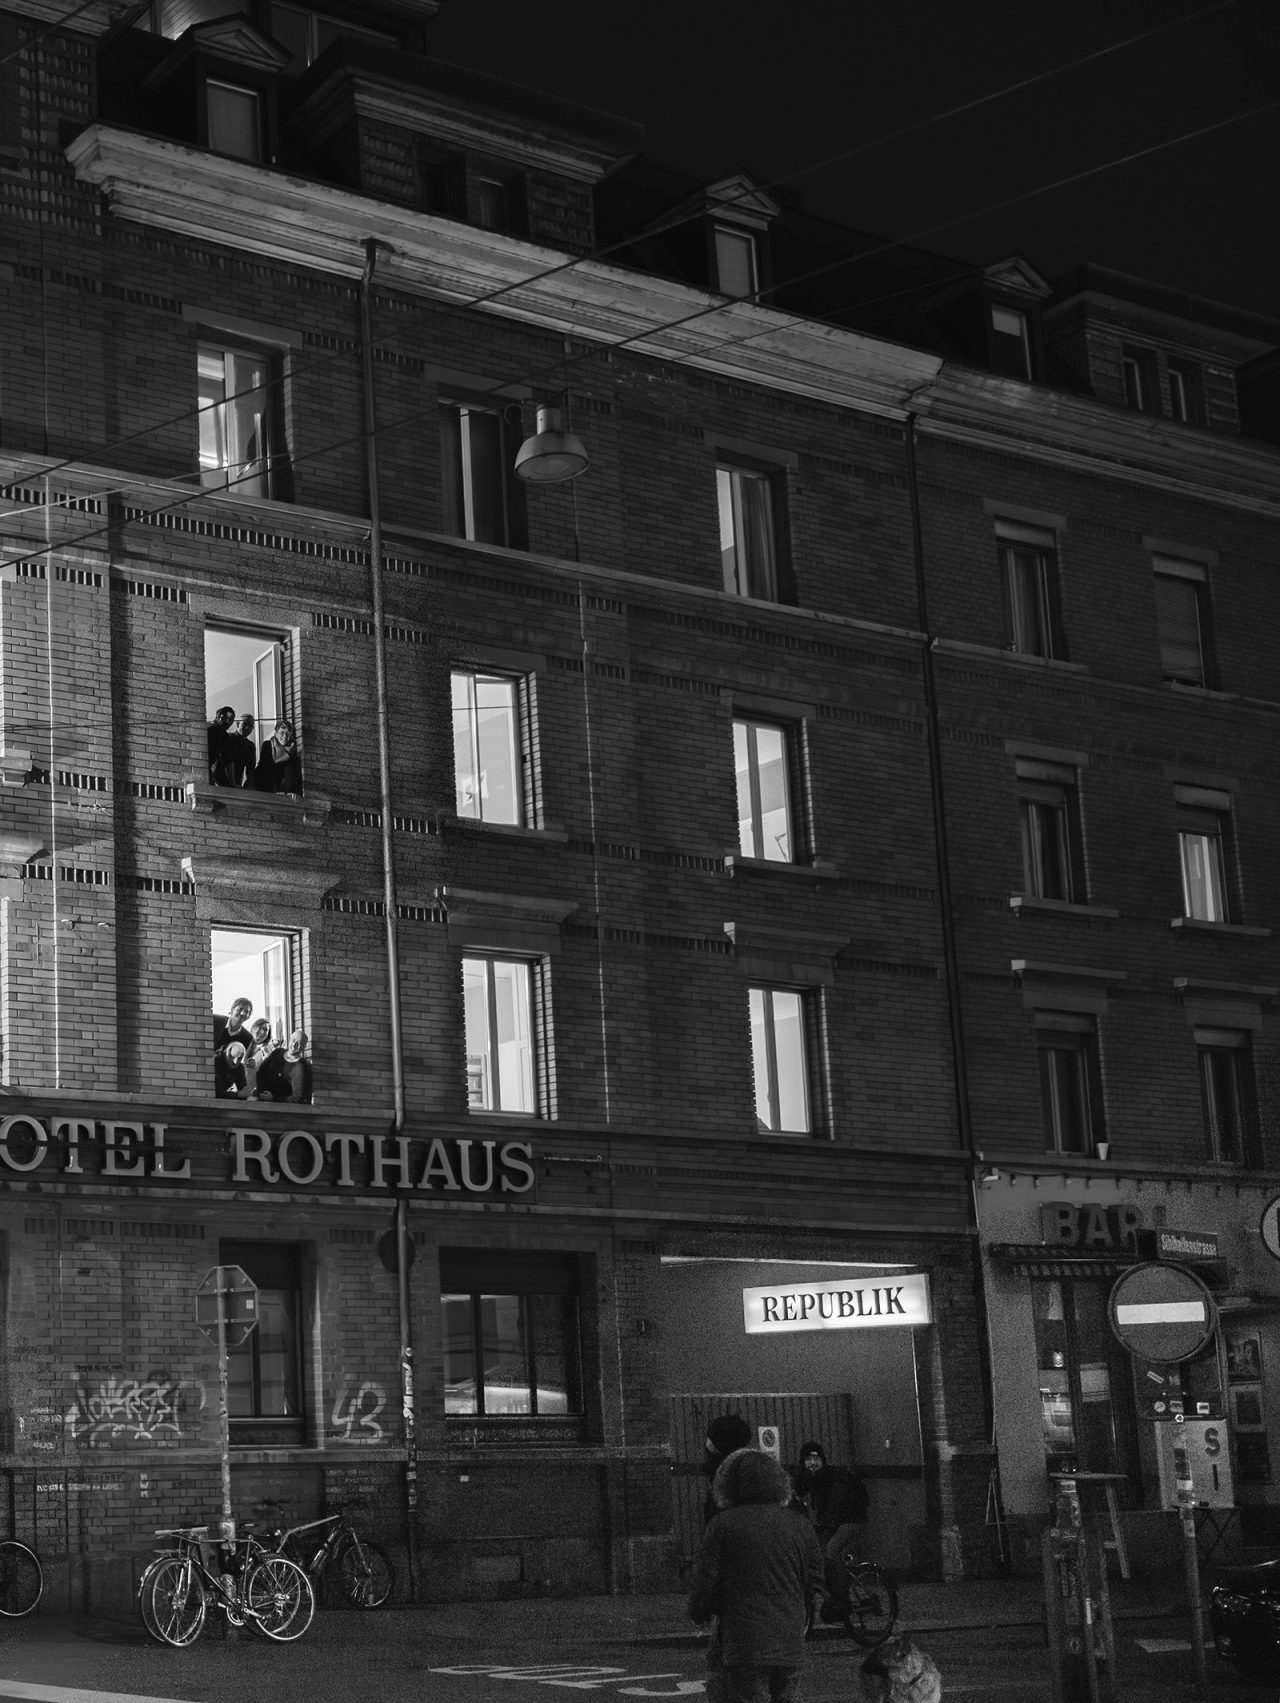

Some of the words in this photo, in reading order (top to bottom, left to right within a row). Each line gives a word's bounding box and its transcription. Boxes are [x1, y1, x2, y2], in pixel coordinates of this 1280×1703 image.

[231, 1127, 535, 1193] ROTHAUS
[1042, 1202, 1144, 1250] BAR
[761, 1286, 907, 1323] REPUBLIK
